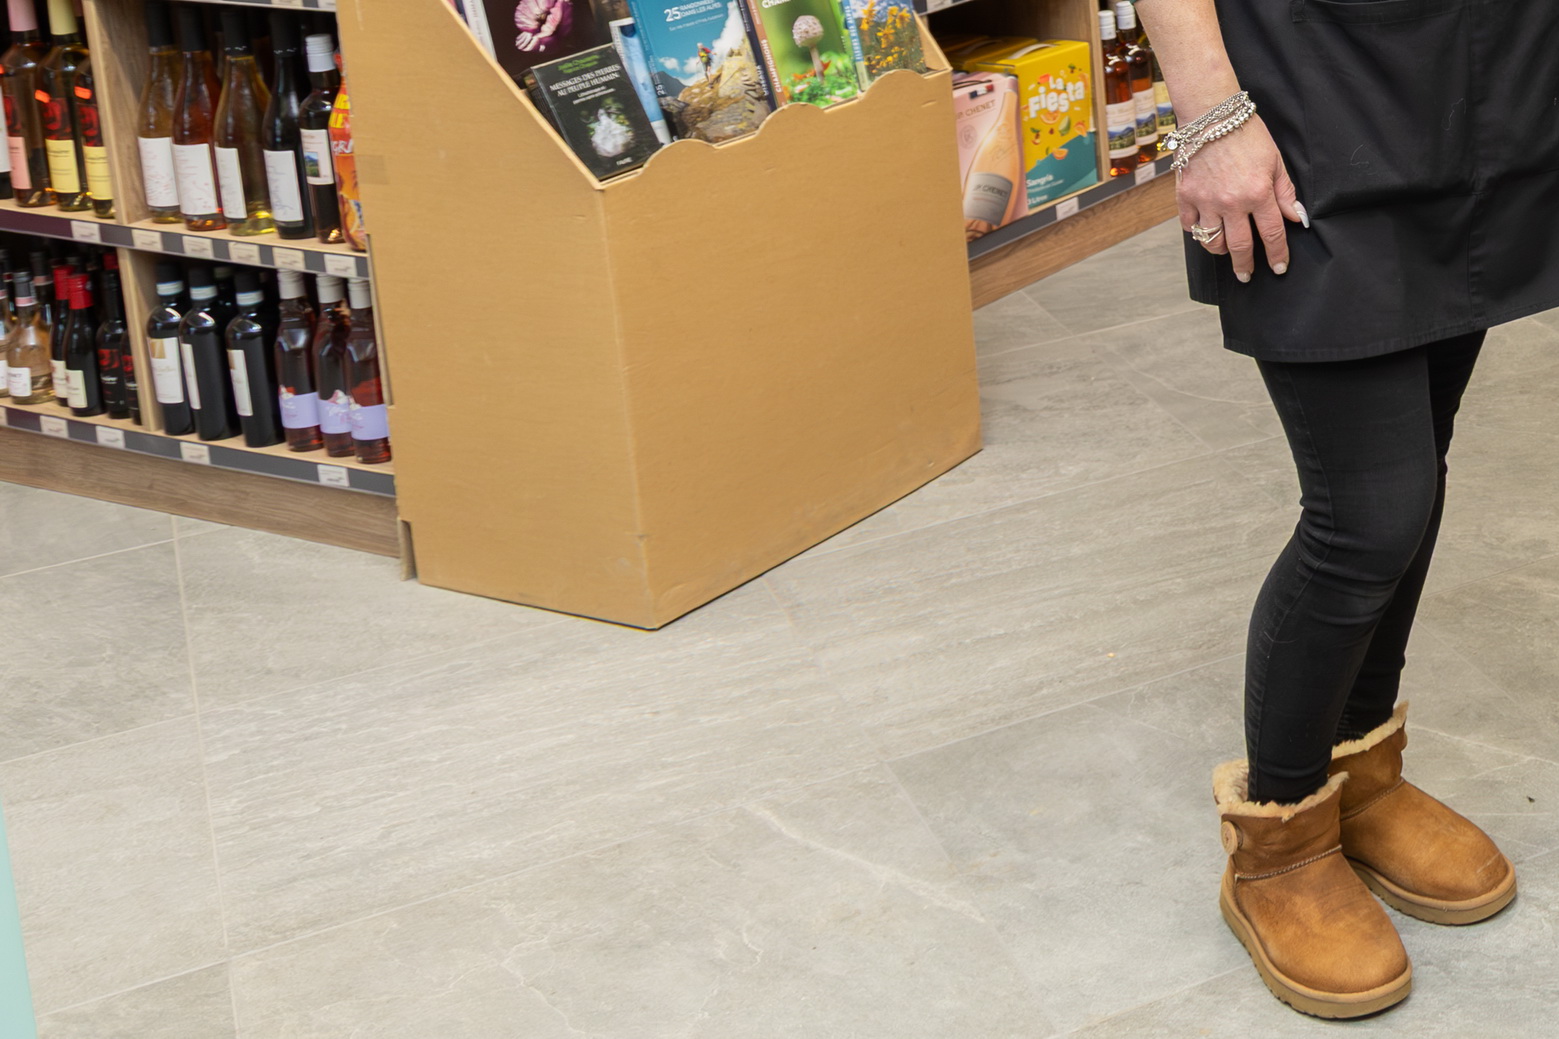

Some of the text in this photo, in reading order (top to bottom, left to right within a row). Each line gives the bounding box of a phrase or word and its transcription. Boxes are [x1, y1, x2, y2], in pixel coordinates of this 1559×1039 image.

[664, 7, 681, 22] 25
[680, 8, 699, 17] DANS
[706, 3, 722, 12] ALPES
[761, 39, 782, 93] CHAMPIGNONS
[550, 75, 582, 91] MESSAGES
[582, 71, 595, 81] DES
[594, 64, 622, 77] PIERRES
[1050, 76, 1064, 90] La
[557, 89, 568, 97] AU
[567, 80, 590, 94] PEUPLE
[656, 84, 666, 96] 25
[1028, 81, 1085, 118] Fiesta
[965, 99, 996, 117] CHENET
[1026, 173, 1053, 187] Sangria
